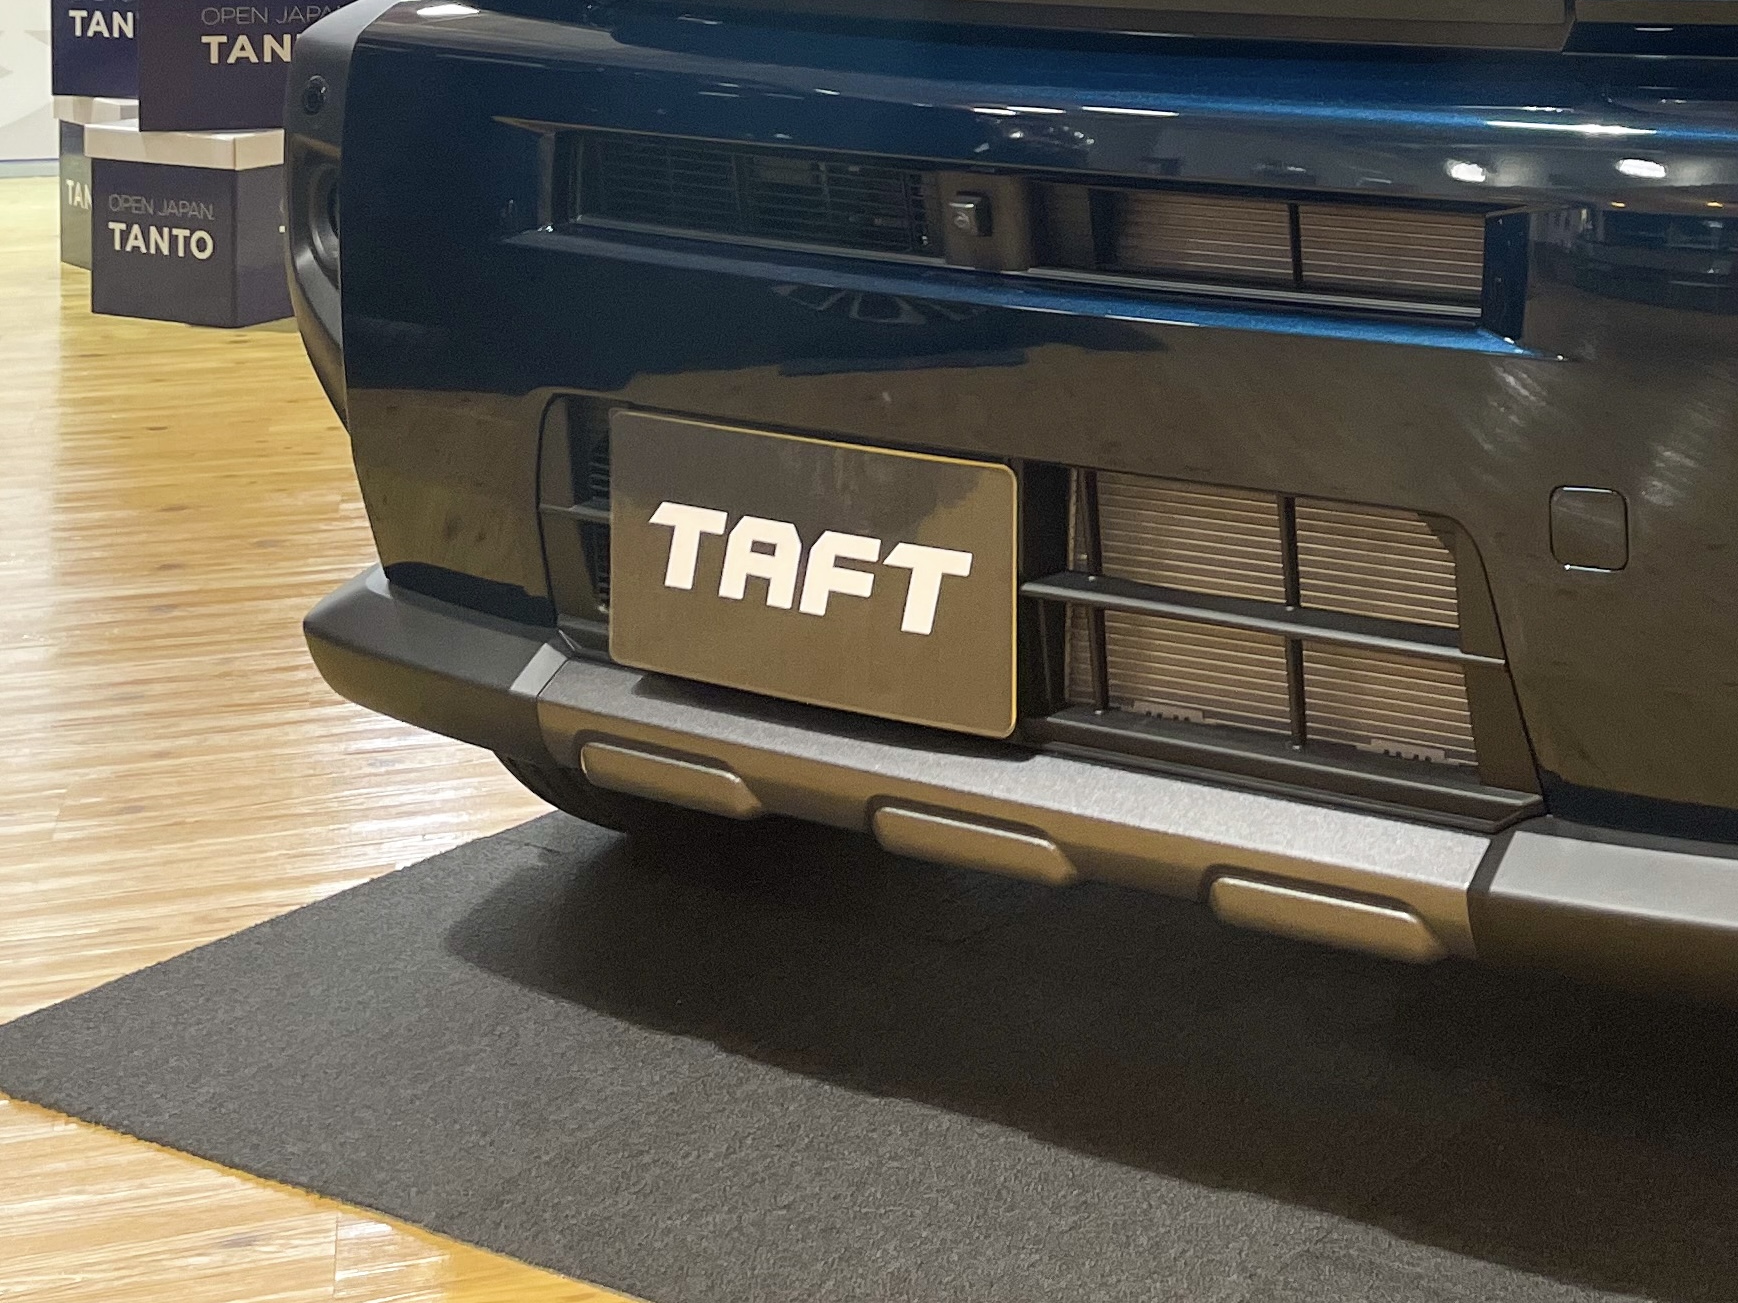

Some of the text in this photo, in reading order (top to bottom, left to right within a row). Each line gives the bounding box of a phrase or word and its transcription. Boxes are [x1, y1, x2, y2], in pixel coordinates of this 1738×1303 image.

[68, 9, 135, 39] TAN
[201, 6, 269, 26] OPEN
[201, 33, 295, 64] TAN
[66, 179, 92, 211] TAN
[108, 194, 154, 216] OPEN
[108, 221, 214, 260] TANTO
[648, 501, 973, 636] TAFT
